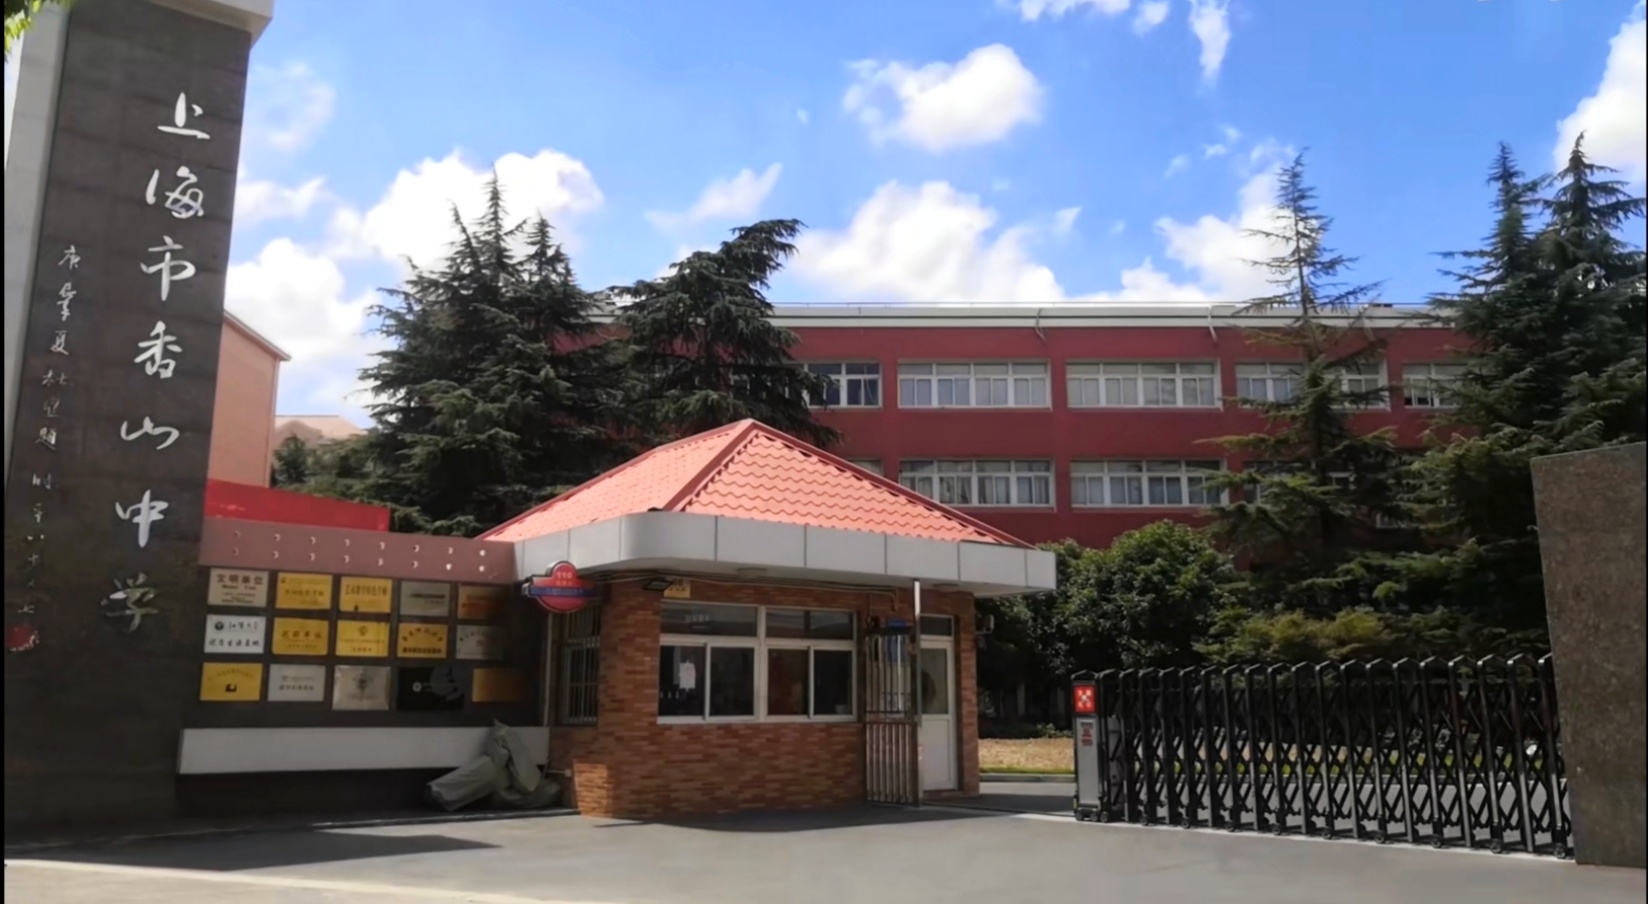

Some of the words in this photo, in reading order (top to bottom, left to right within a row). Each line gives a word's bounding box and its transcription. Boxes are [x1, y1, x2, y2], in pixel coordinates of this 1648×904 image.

[99, 91, 211, 633] 上海市香山中学
